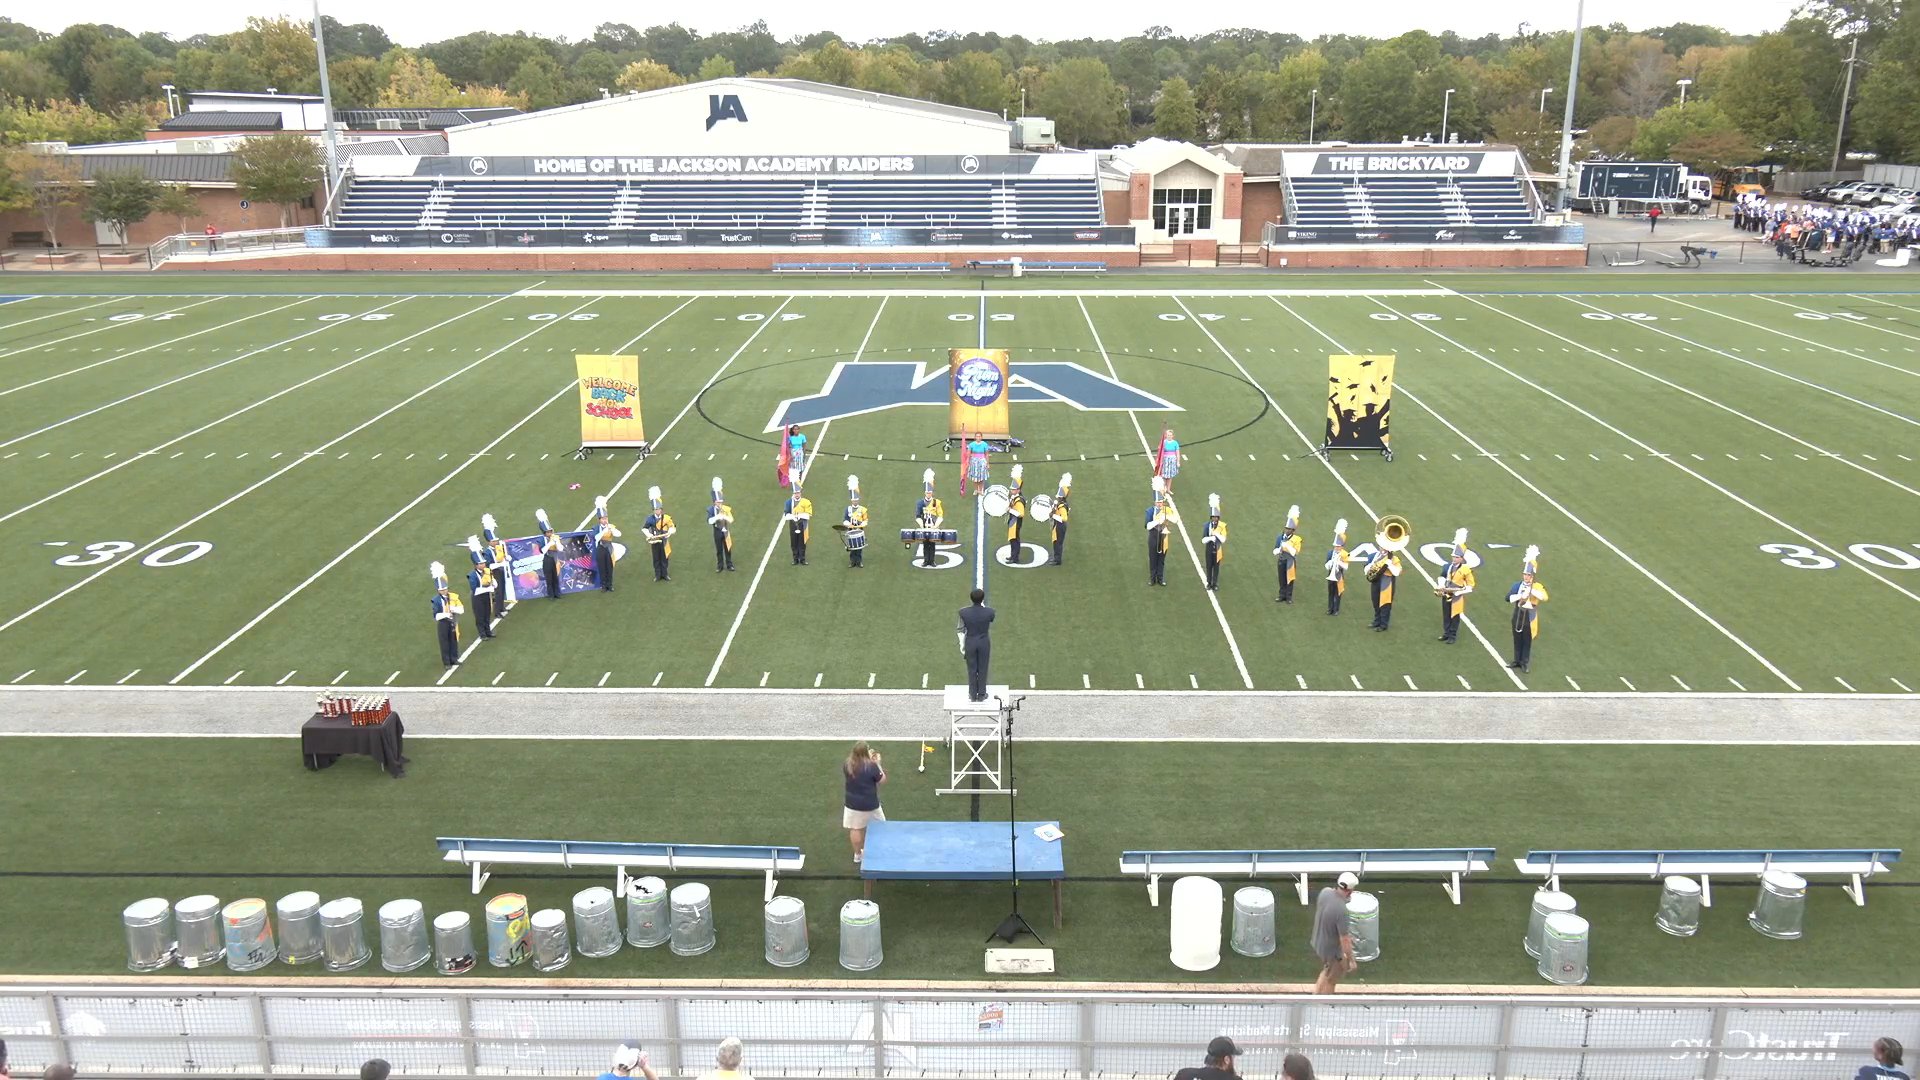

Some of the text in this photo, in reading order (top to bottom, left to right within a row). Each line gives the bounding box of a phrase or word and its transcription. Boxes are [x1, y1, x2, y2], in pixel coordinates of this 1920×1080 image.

[706, 95, 748, 132] JA
[534, 157, 915, 173] HOME OF THE JACKSON ACADEMY RAIDERS
[1328, 156, 1470, 171] THE BRICKYARD
[720, 233, 753, 242] TrustCare
[957, 363, 1000, 382] Prom
[583, 377, 637, 396] WELCOME
[591, 387, 627, 403] BACK
[957, 379, 998, 400] Night
[586, 402, 633, 420] SCHOOL
